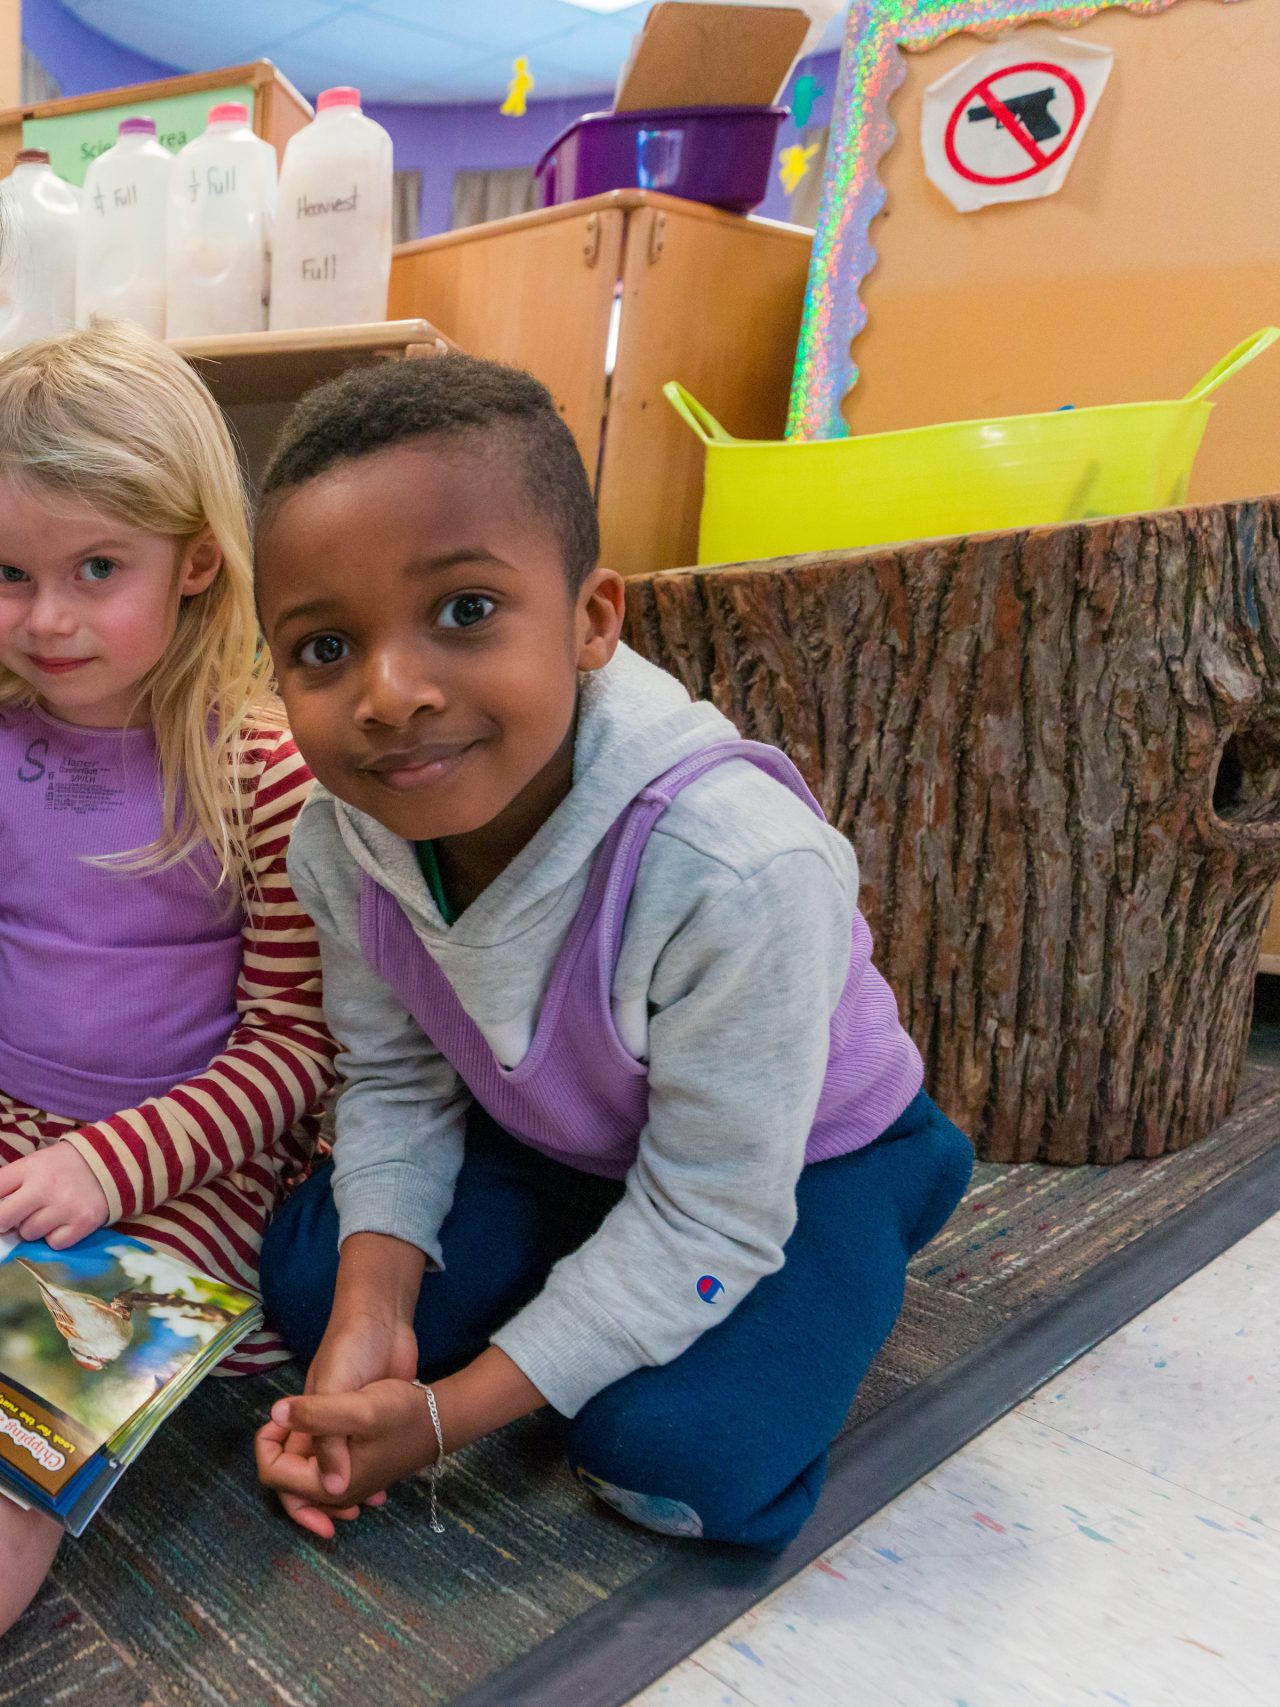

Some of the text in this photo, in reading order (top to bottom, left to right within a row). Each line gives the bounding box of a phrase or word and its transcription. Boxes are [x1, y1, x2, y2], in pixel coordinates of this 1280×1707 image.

[159, 131, 187, 147] rea
[207, 166, 236, 196] Full
[114, 185, 137, 208] Full
[301, 253, 337, 280] Full
[18, 1410, 35, 1425] the
[36, 1422, 51, 1437] for
[4, 1420, 63, 1468] Chipping
[52, 1433, 77, 1454] Look
